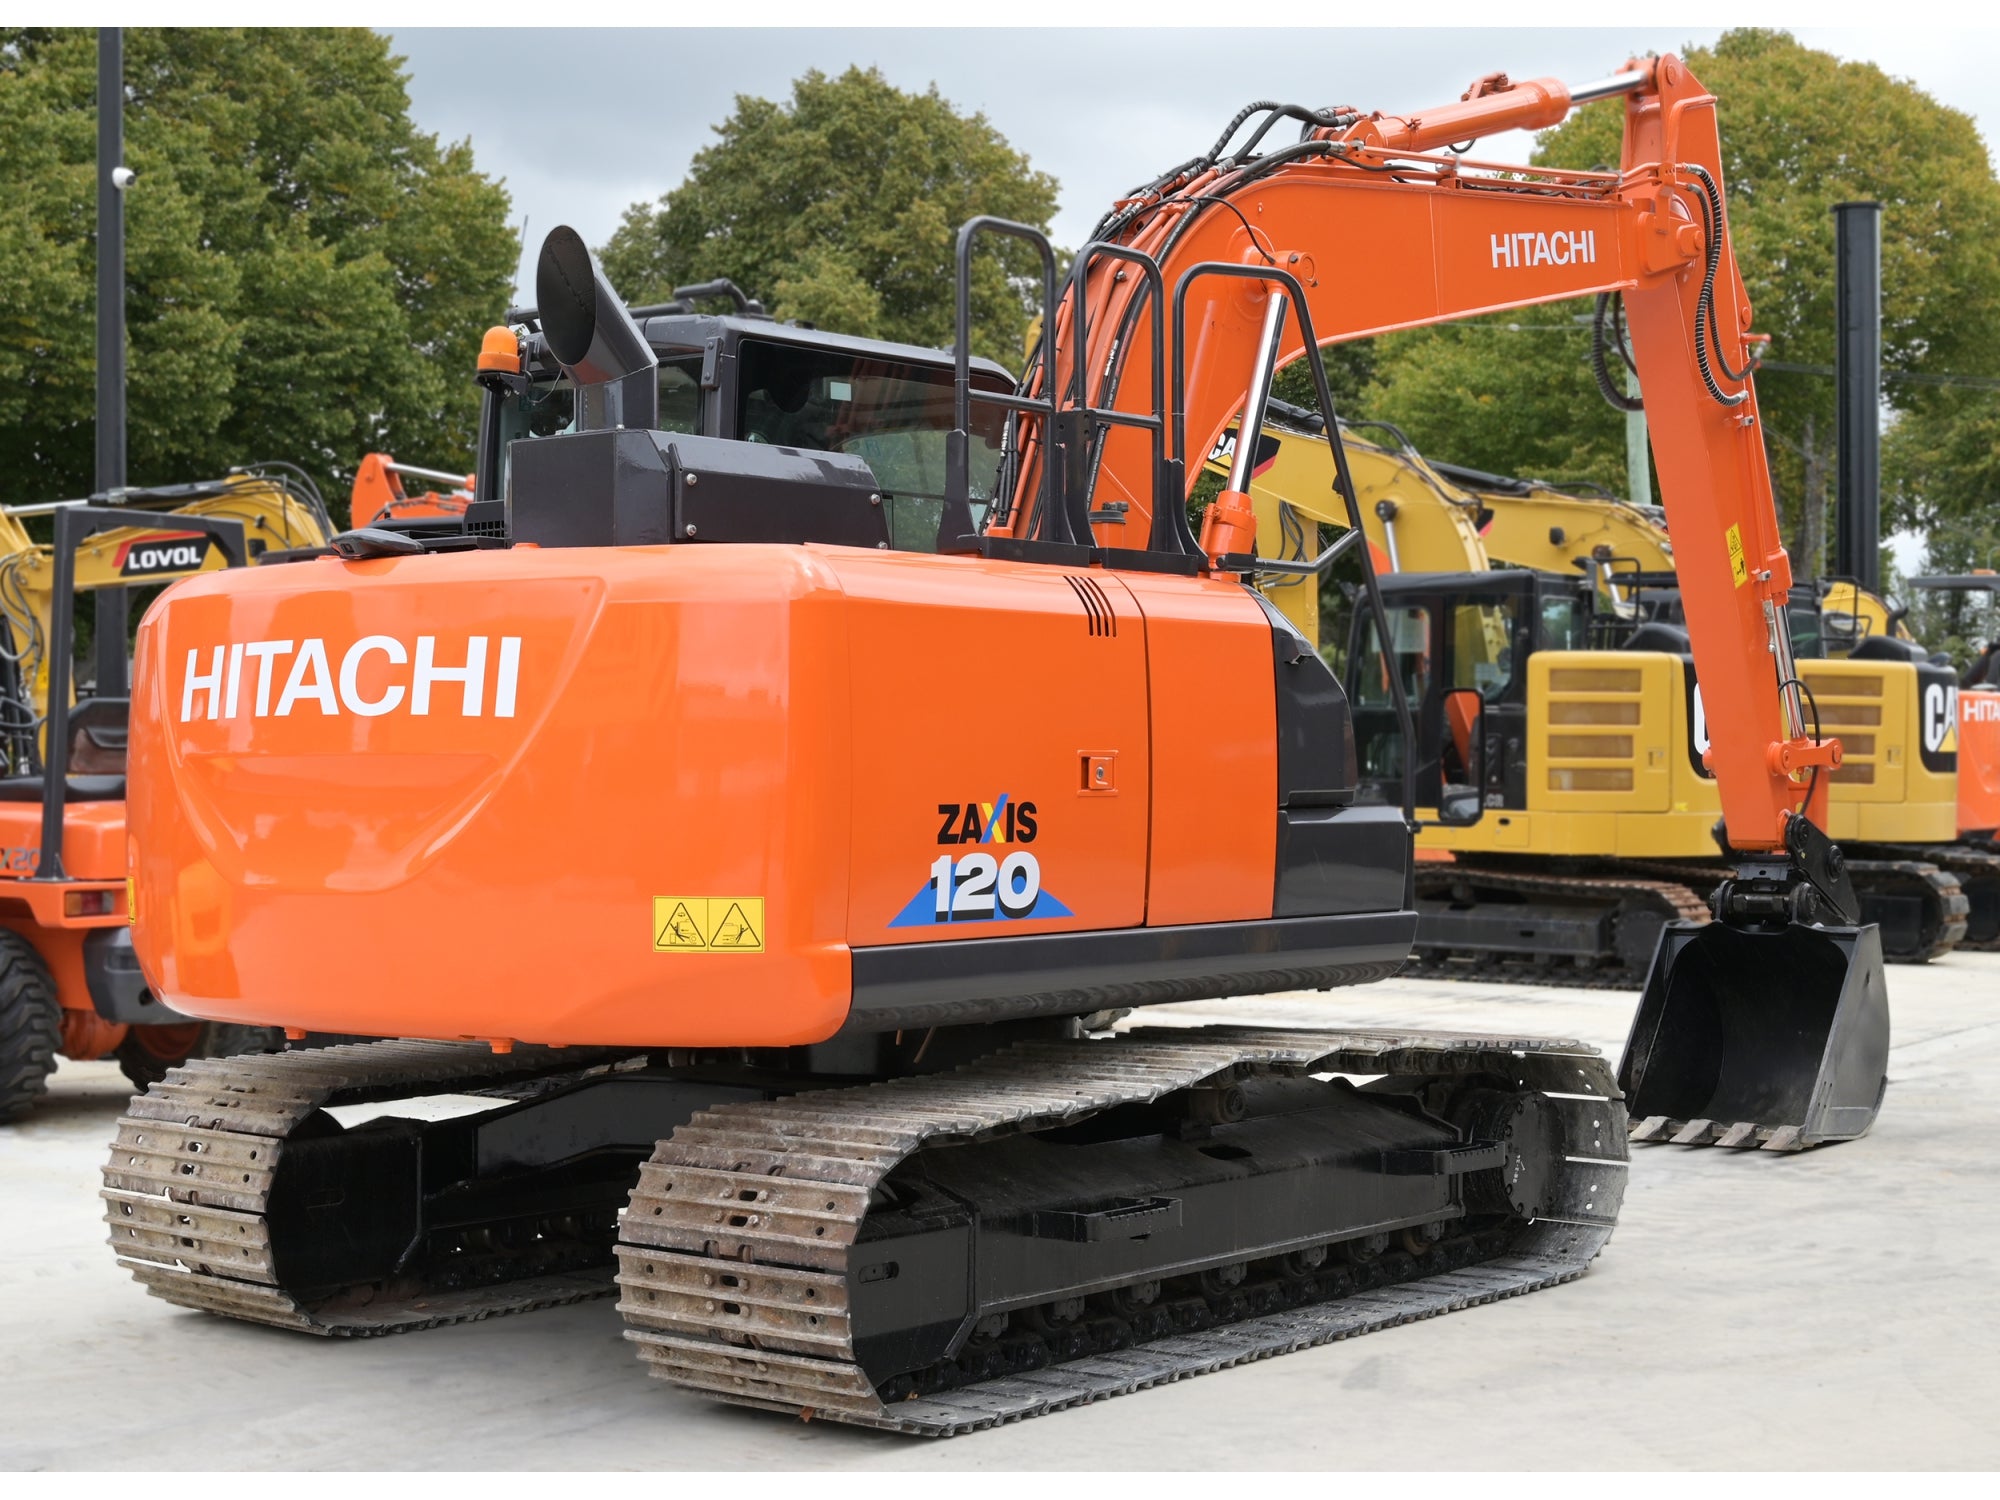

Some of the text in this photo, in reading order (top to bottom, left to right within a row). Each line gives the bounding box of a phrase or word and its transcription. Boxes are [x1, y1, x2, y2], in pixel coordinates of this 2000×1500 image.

[1490, 230, 1596, 268] HITACHI
[1208, 433, 1237, 461] CA
[128, 546, 202, 570] LOVOL
[180, 634, 522, 723] HITACHI
[1924, 683, 1958, 752] CA
[1963, 699, 2000, 722] HITA
[937, 793, 1038, 844] ZAXIS
[0, 847, 41, 871] X20
[930, 850, 1041, 920] 120
